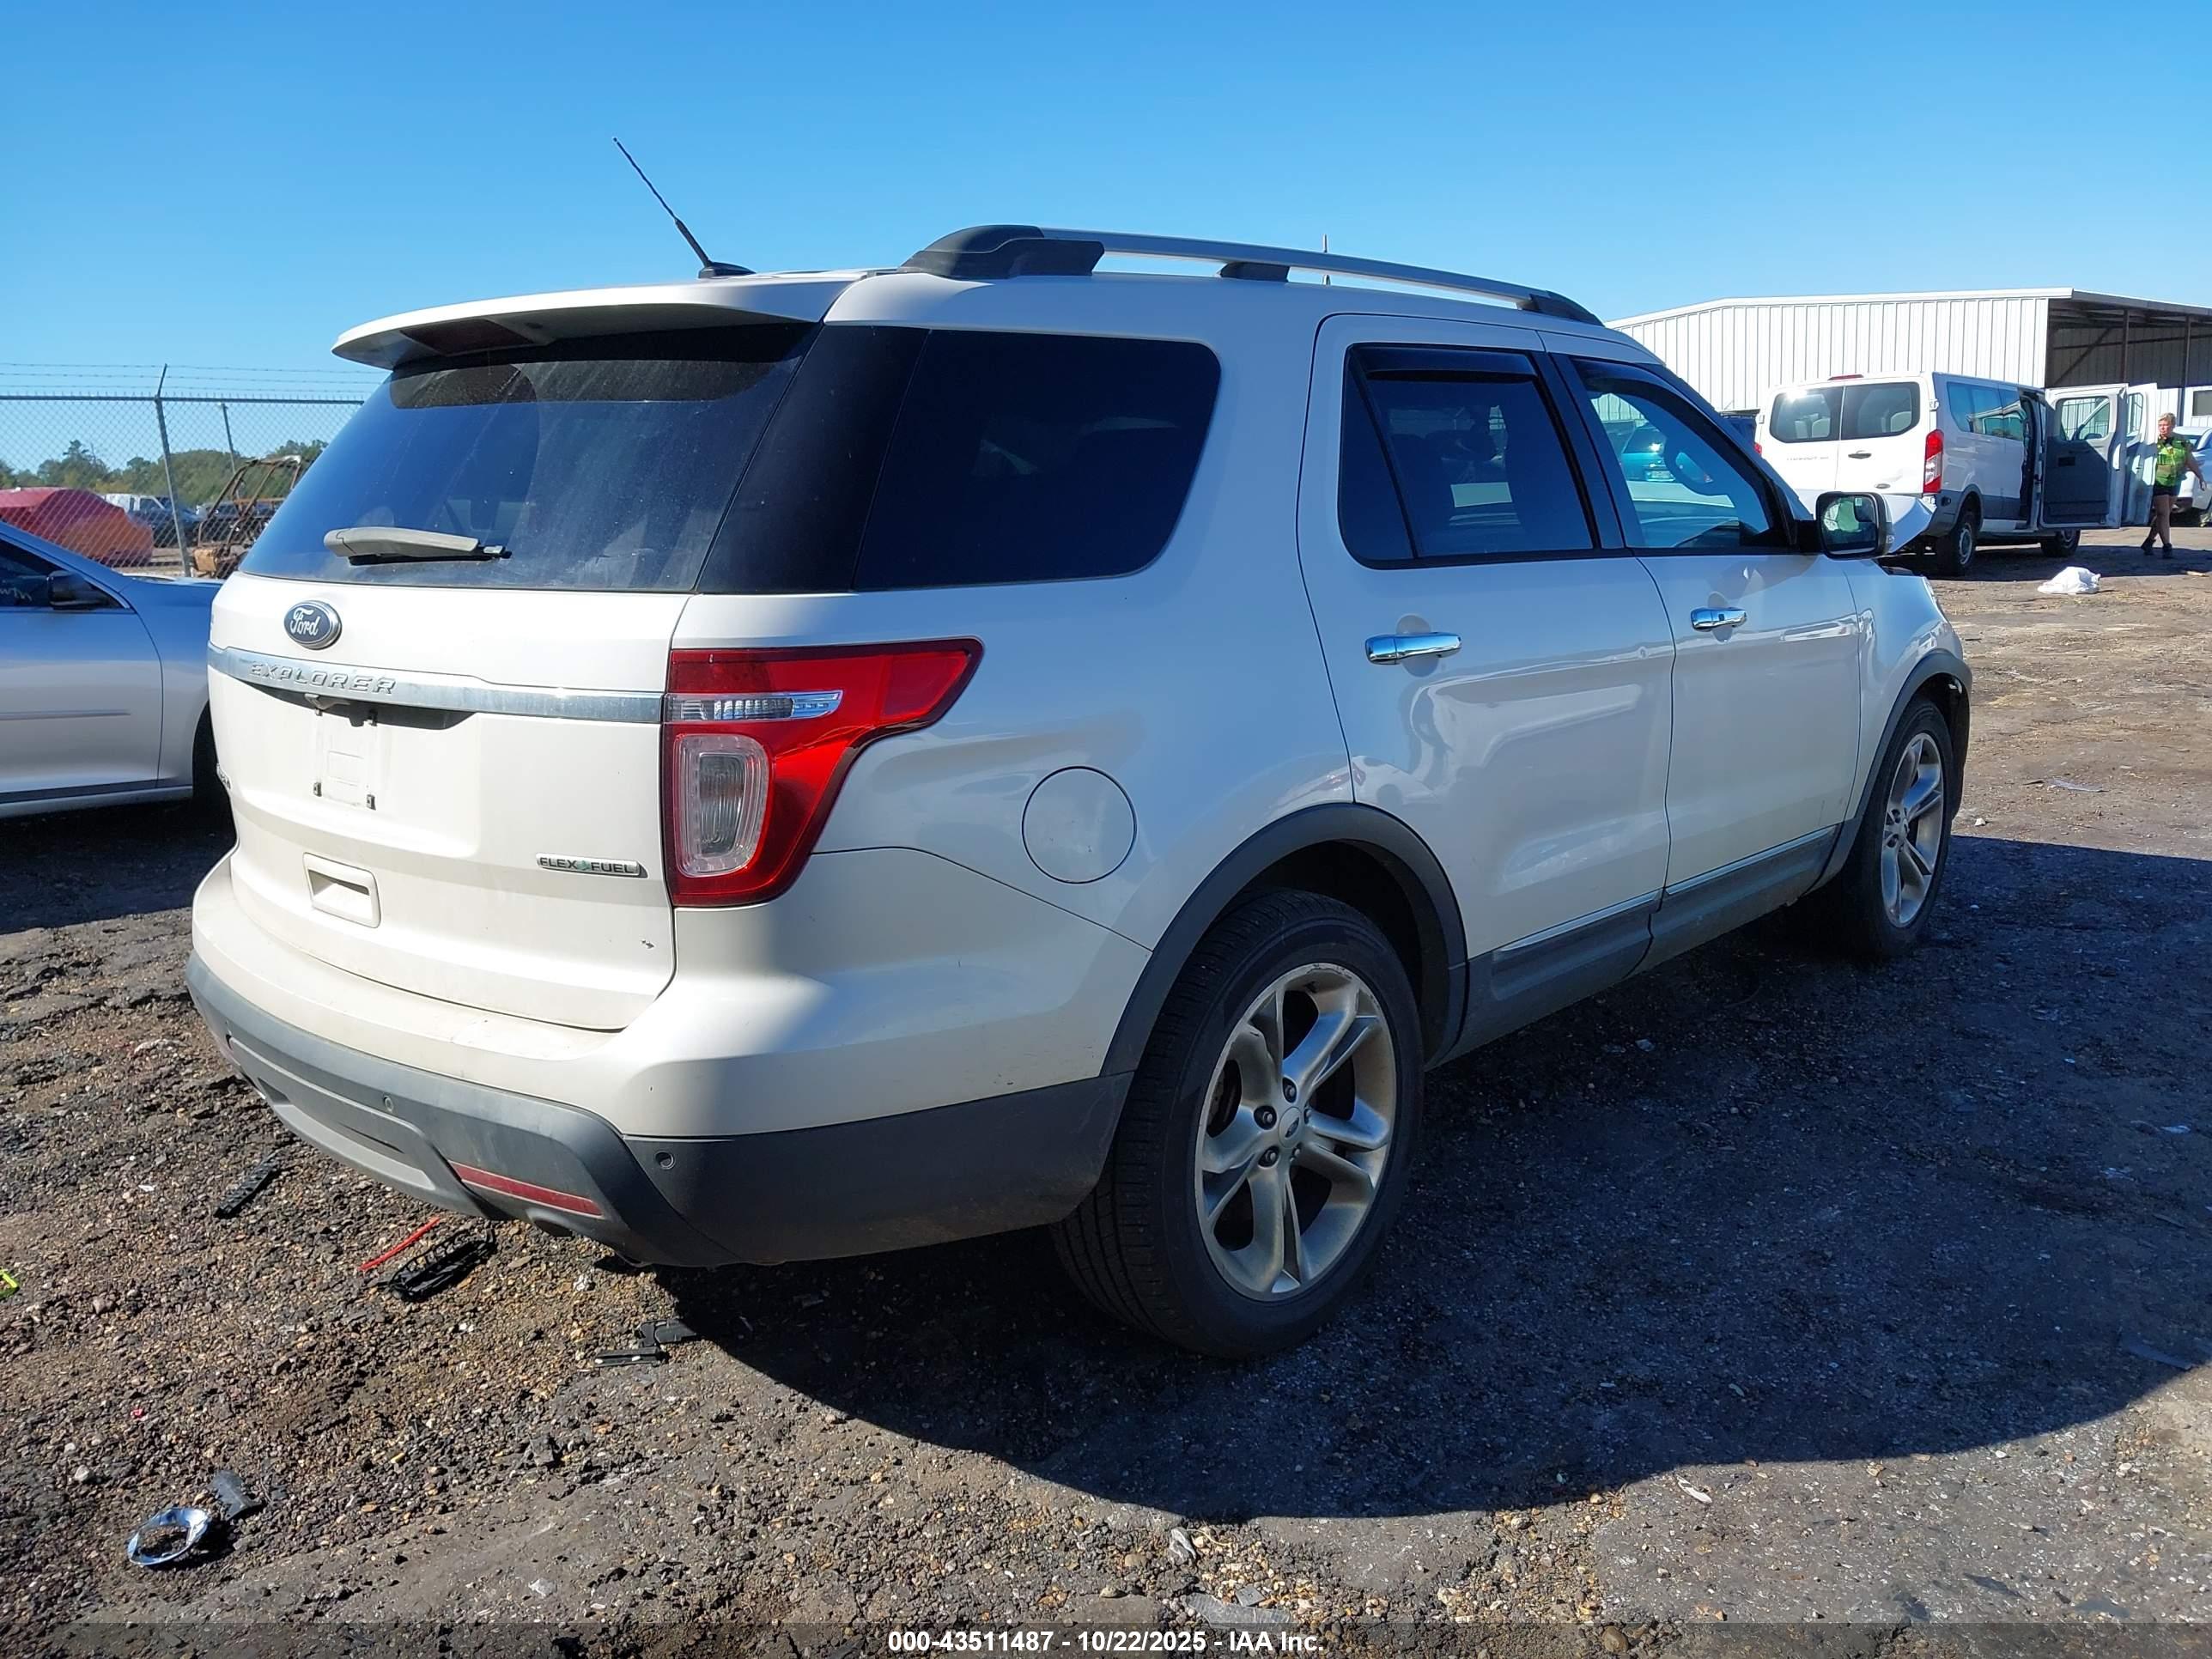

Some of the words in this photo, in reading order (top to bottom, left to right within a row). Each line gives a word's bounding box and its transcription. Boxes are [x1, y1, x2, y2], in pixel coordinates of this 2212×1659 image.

[289, 606, 321, 636] Ford
[249, 662, 397, 695] EXPLORER
[539, 857, 578, 870] FLEX
[591, 862, 635, 874] FUEL
